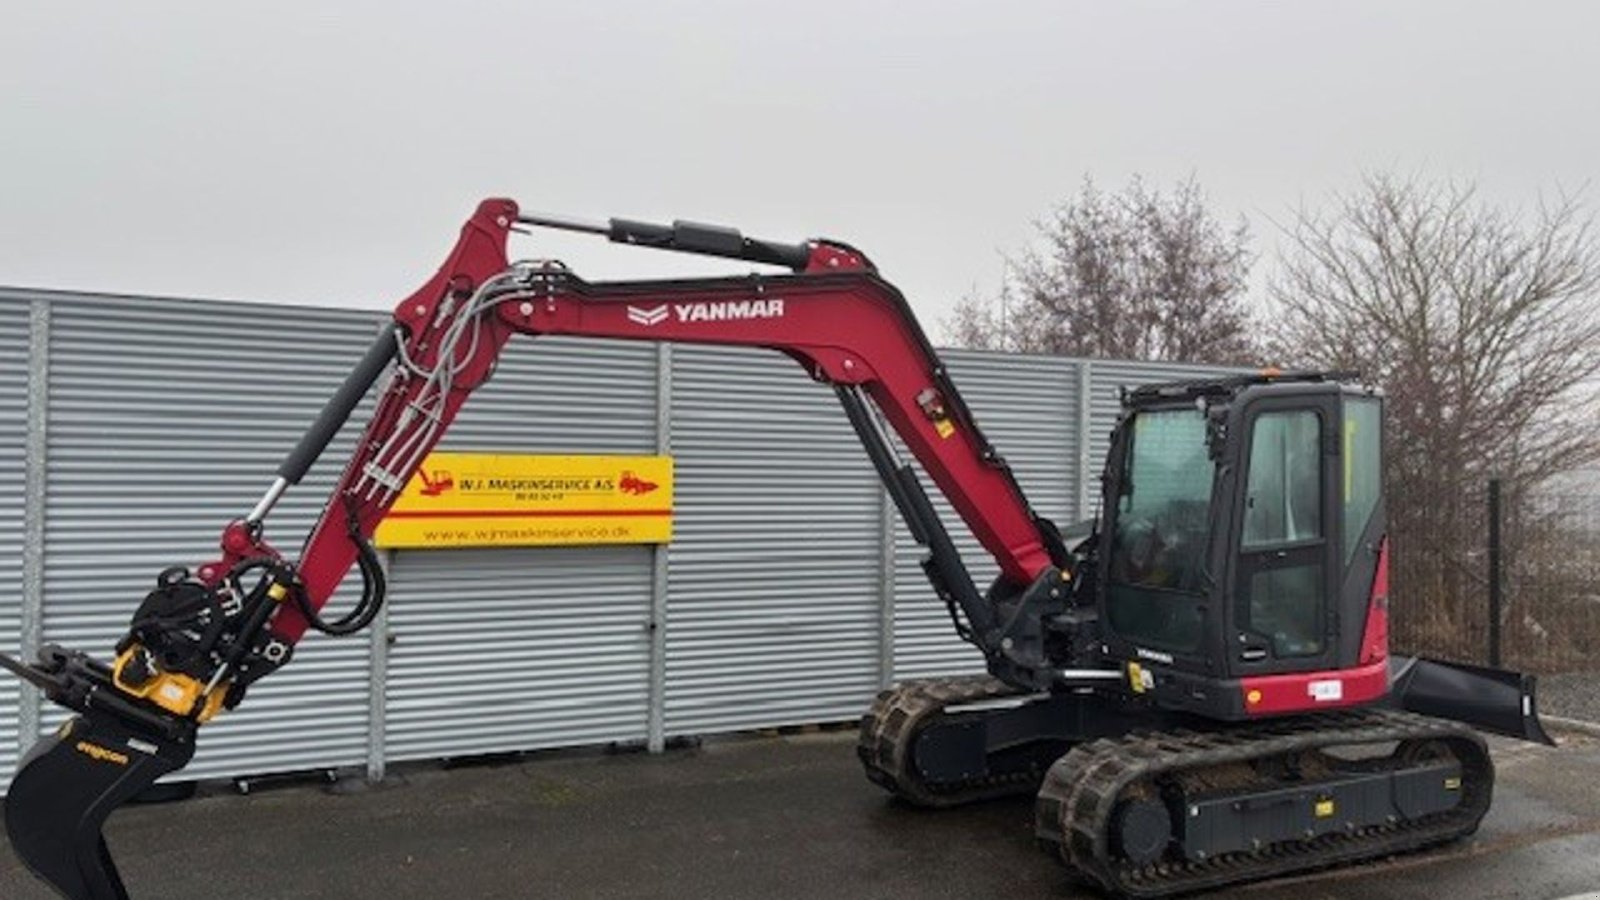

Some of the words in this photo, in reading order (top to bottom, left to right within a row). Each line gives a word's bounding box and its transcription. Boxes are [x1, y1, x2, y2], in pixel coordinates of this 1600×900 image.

[674, 300, 785, 322] YANMAR
[488, 479, 591, 491] MASKINSERVICE
[594, 480, 615, 491] A/S
[423, 526, 631, 541] www.wjmaskinservice.dk
[76, 741, 129, 765] engcon
